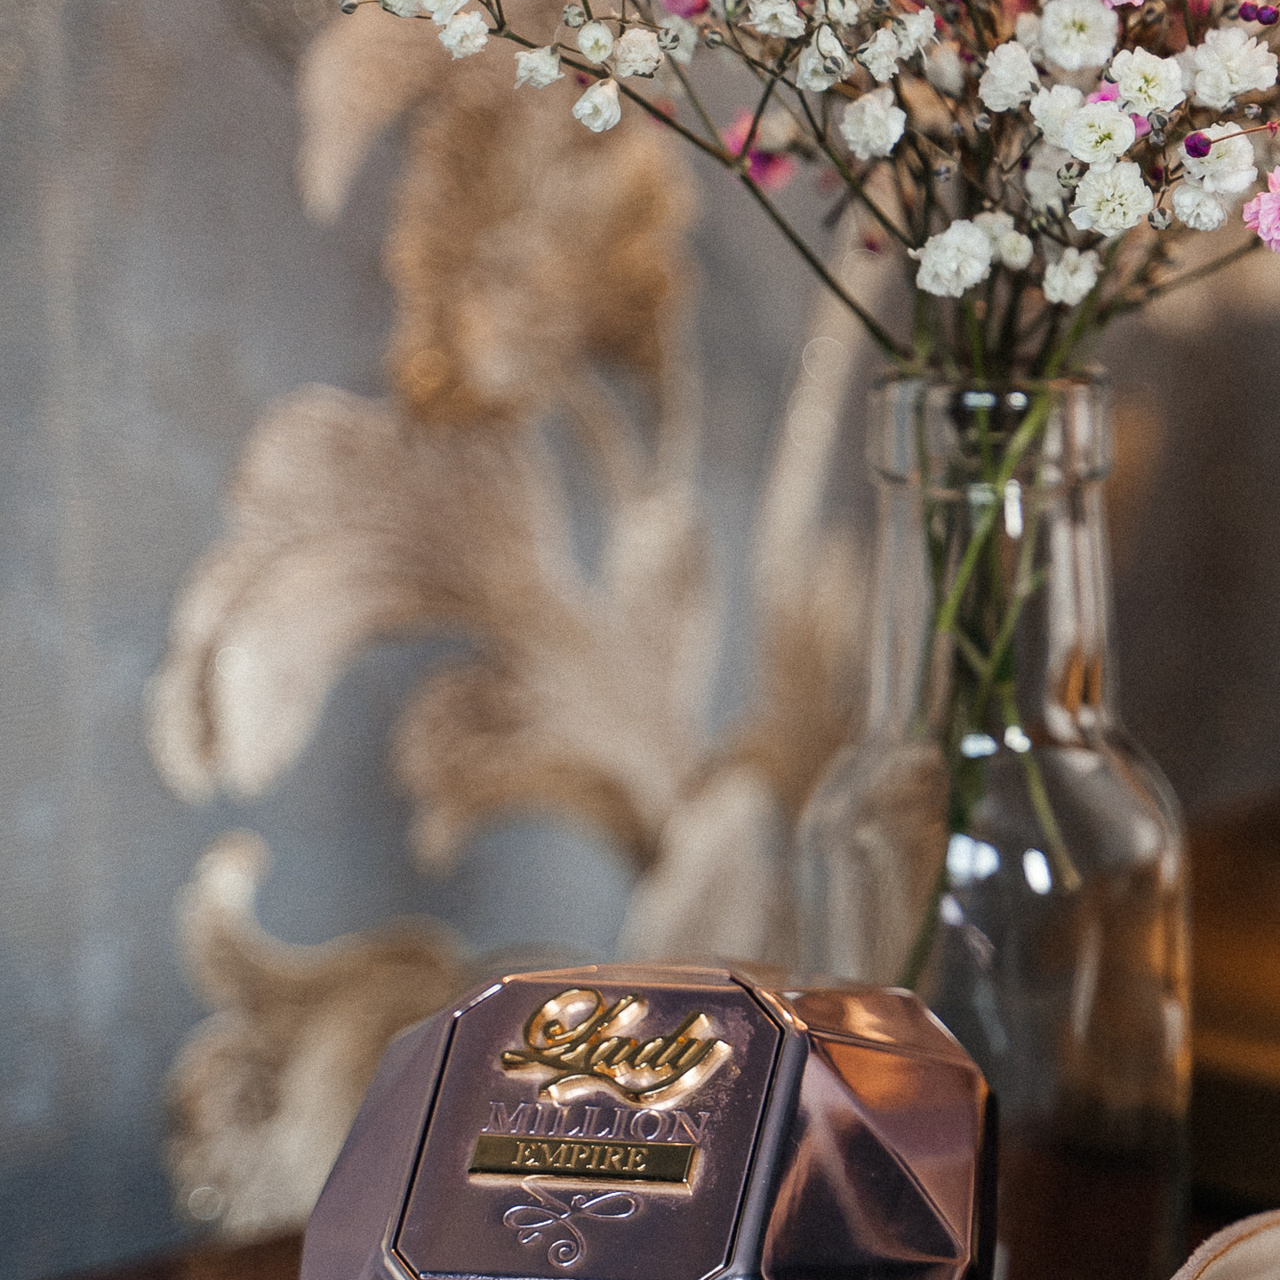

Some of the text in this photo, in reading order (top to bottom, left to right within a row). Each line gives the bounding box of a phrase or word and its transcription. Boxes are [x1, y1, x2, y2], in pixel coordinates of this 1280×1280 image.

[501, 988, 732, 1109] Lady
[482, 1102, 710, 1141] MILLION
[511, 1141, 648, 1171] EMPIRE
